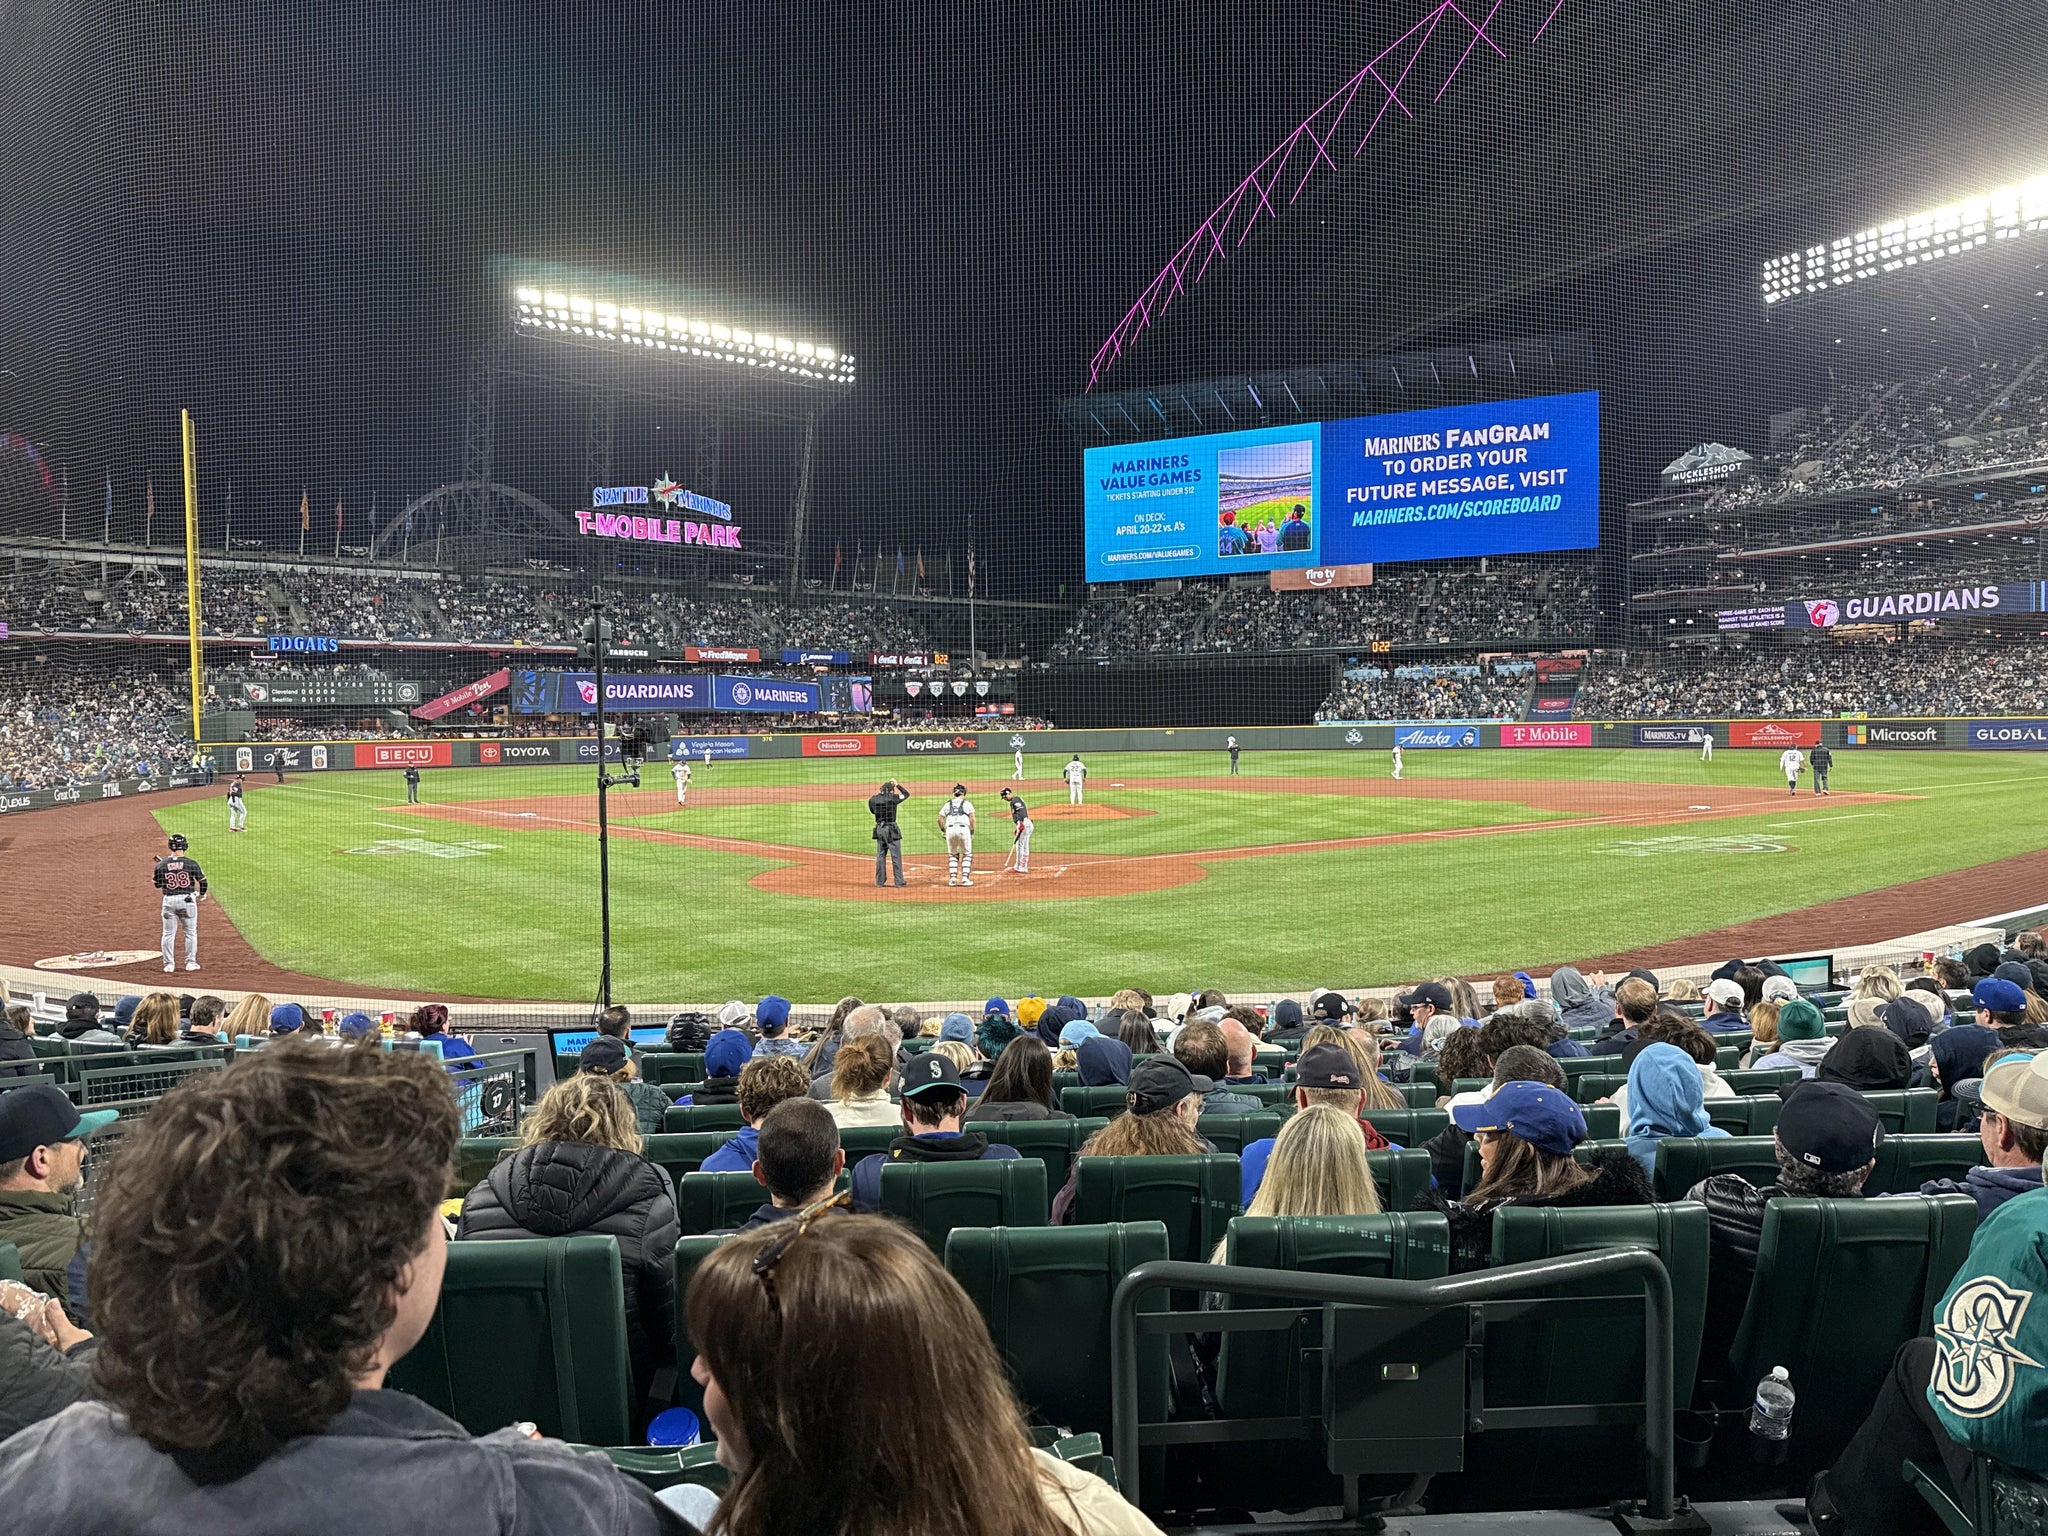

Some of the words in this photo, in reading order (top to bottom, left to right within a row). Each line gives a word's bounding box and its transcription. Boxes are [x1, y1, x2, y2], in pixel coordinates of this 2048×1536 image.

[1364, 433, 1440, 457] MARINERS
[1112, 454, 1189, 474] MARINERS
[1383, 460, 1406, 476] TO
[1410, 454, 1472, 473] ORDER
[1476, 447, 1528, 467] YOUR
[1671, 462, 1742, 481] MUCKLESHOOT
[1100, 475, 1146, 491] VALUE
[1149, 469, 1201, 486] GAMES
[1346, 482, 1417, 503] FUTURE
[1421, 473, 1515, 496] MESSAGE,
[1519, 468, 1568, 487] VISIT
[1106, 492, 1131, 501] TICKETS
[1132, 489, 1161, 500] STARTING
[1162, 487, 1183, 498] UNDER
[1184, 486, 1195, 496] $12
[593, 487, 648, 506] SEATTLE
[677, 489, 732, 520] MARINERS
[1352, 494, 1562, 527] MARINERS.COM/SCOREBOARD
[1134, 513, 1145, 522] ON
[1146, 512, 1166, 522] DECK:
[575, 511, 681, 542] T-MOBILE
[684, 521, 742, 548] PARK
[1116, 524, 1139, 536] APRIL
[1140, 523, 1162, 534] 20-22
[1107, 548, 1194, 562] MARINERS.COM/VALUEGAMES
[1305, 569, 1323, 580] fire
[1326, 570, 1336, 580] tv
[1846, 586, 2000, 619] GUARDIANS
[471, 681, 491, 696] Pen
[606, 684, 694, 698] GUARDIANS
[754, 688, 808, 703] MARINERS
[451, 690, 473, 705] Mobile
[1400, 730, 1451, 745] Alaska
[1528, 727, 1578, 741] Mobile
[1870, 728, 1937, 741] Microsoft
[1976, 728, 2047, 741] GLOBAL
[504, 747, 550, 757] TOYOTA
[579, 745, 613, 756] eeo
[821, 741, 858, 750] Nintendo
[906, 739, 952, 751] KeyBank
[381, 749, 429, 760] BECU
[103, 783, 121, 797] STIHL
[8, 797, 30, 807] LEXUS
[165, 871, 190, 890] 38
[929, 1060, 942, 1079] S
[1931, 1275, 2033, 1419] S
